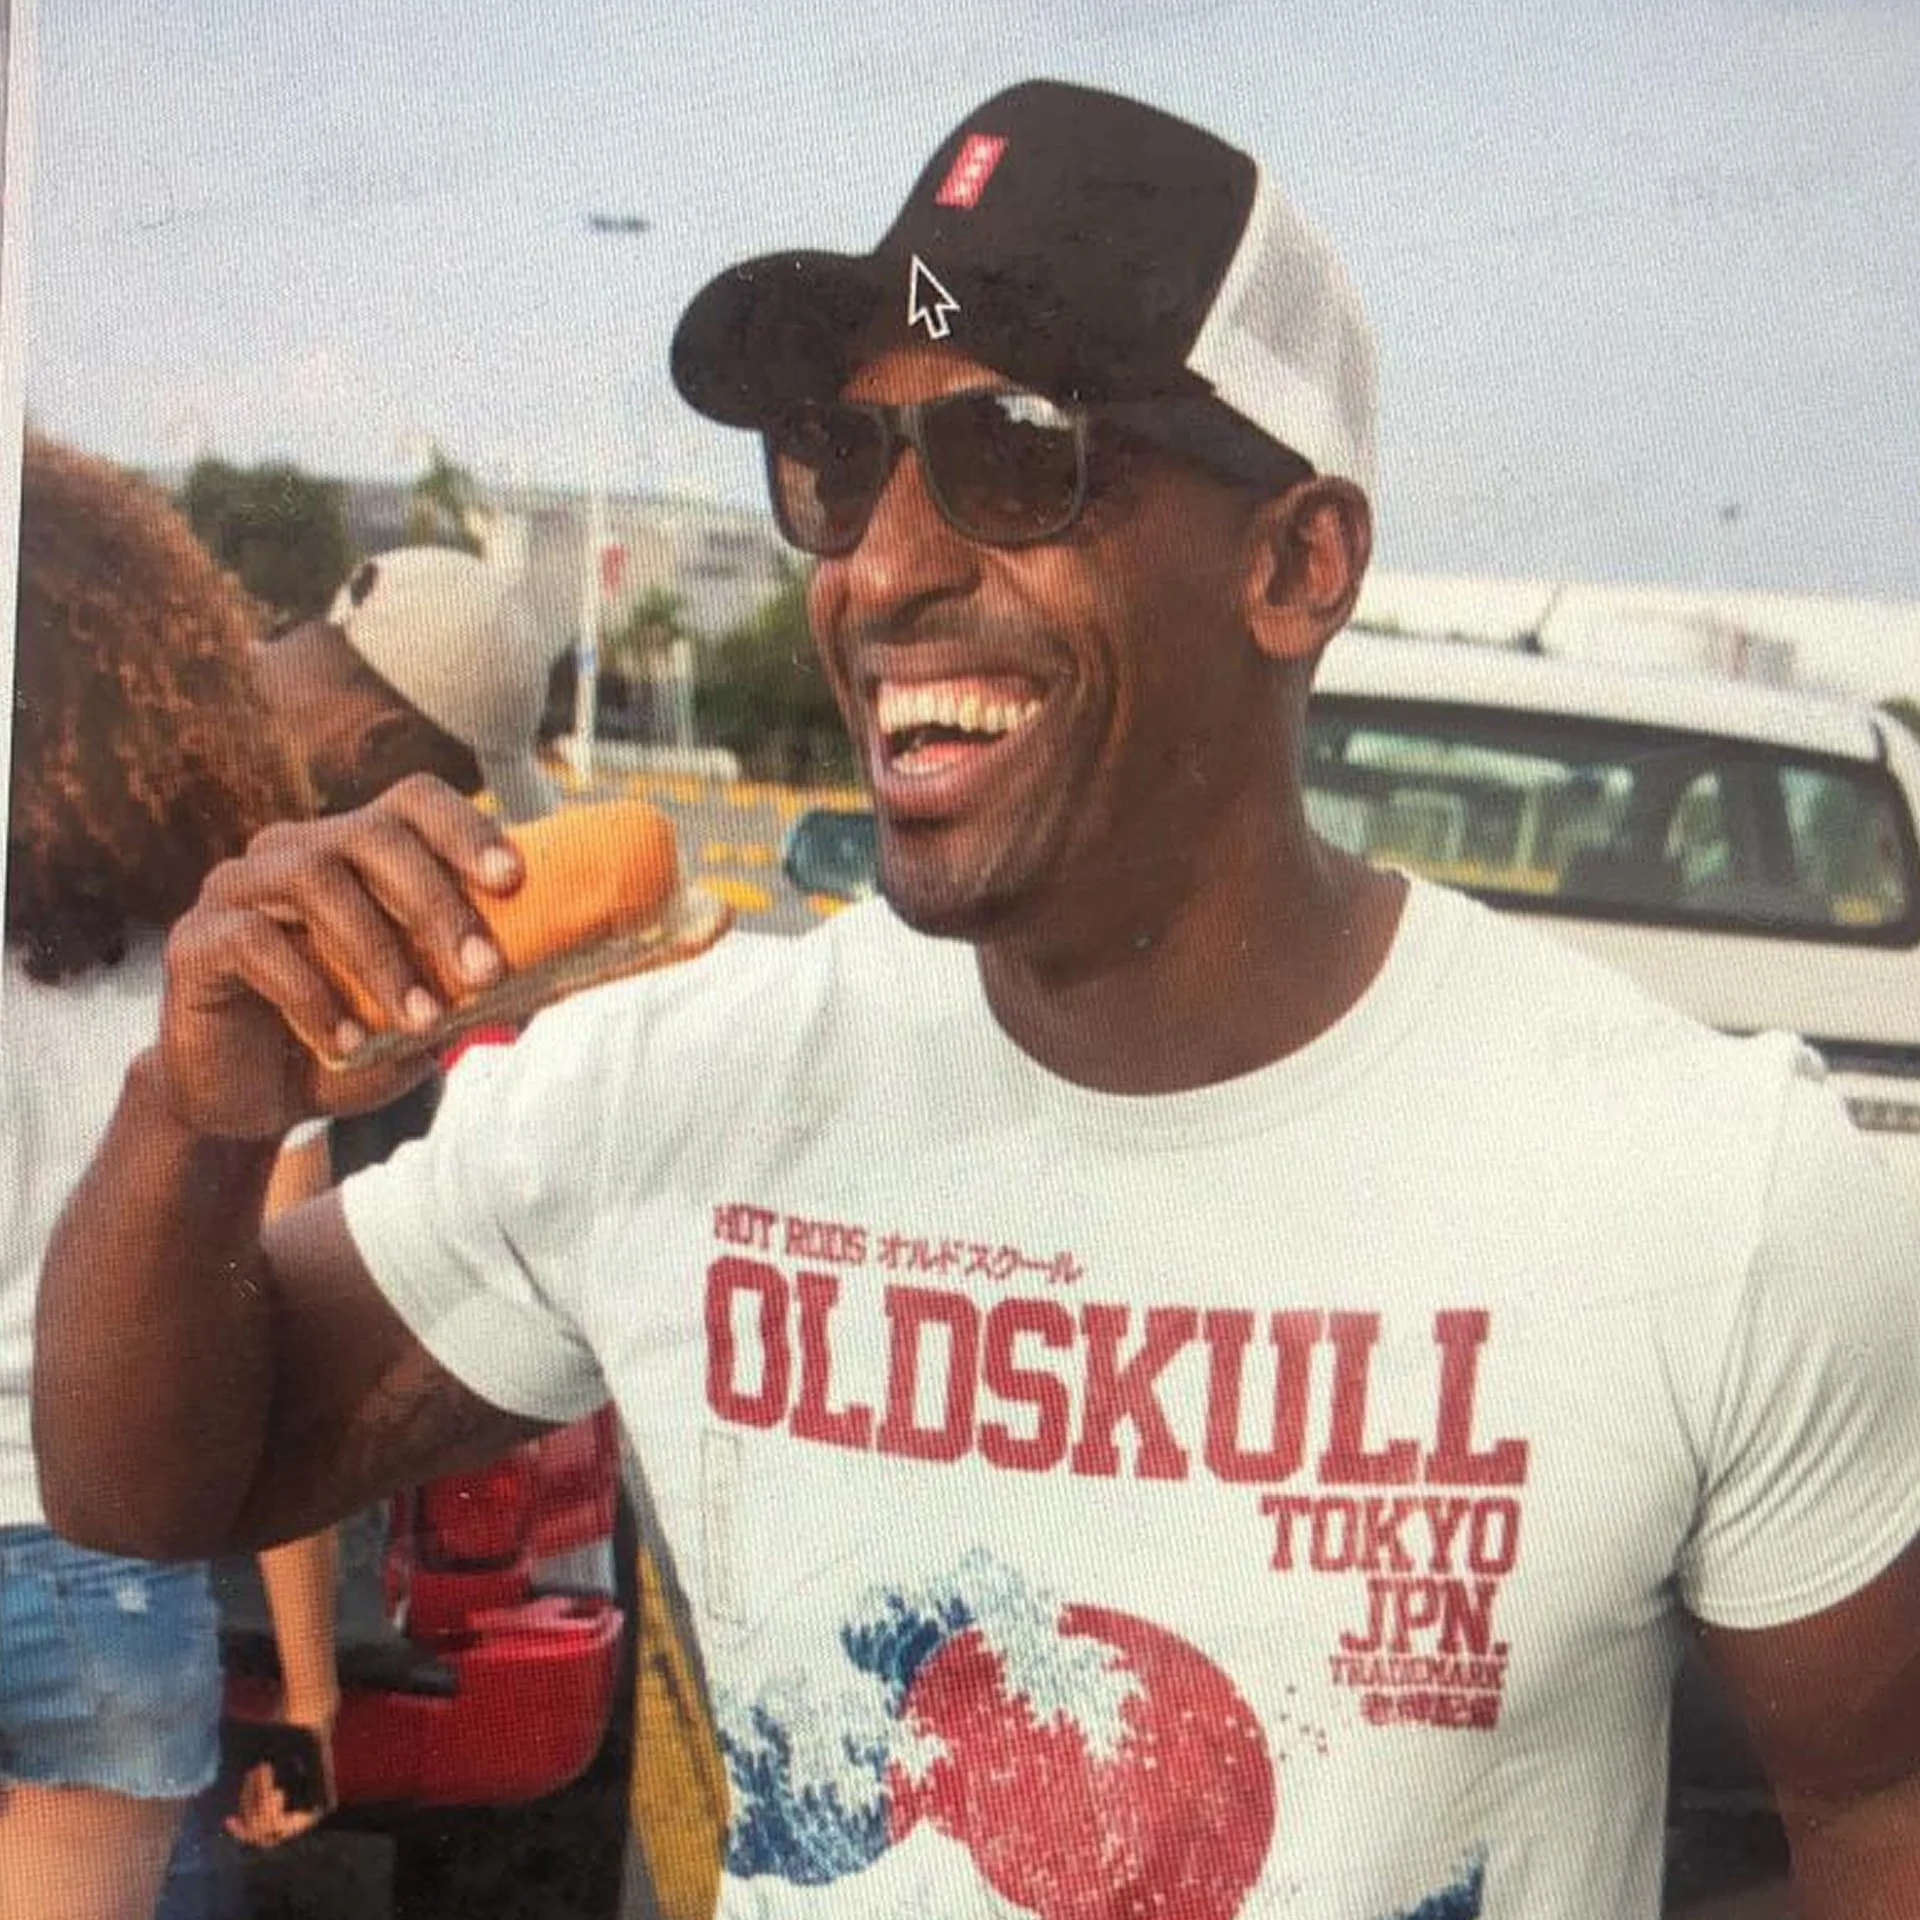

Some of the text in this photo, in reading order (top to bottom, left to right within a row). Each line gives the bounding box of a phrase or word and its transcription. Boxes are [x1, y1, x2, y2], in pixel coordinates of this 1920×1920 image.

[714, 1203, 868, 1266] HOT RODS
[704, 1255, 1529, 1486] OLDSKULL
[1261, 1495, 1521, 1575] TOKYO
[1340, 1578, 1508, 1655] JPN.
